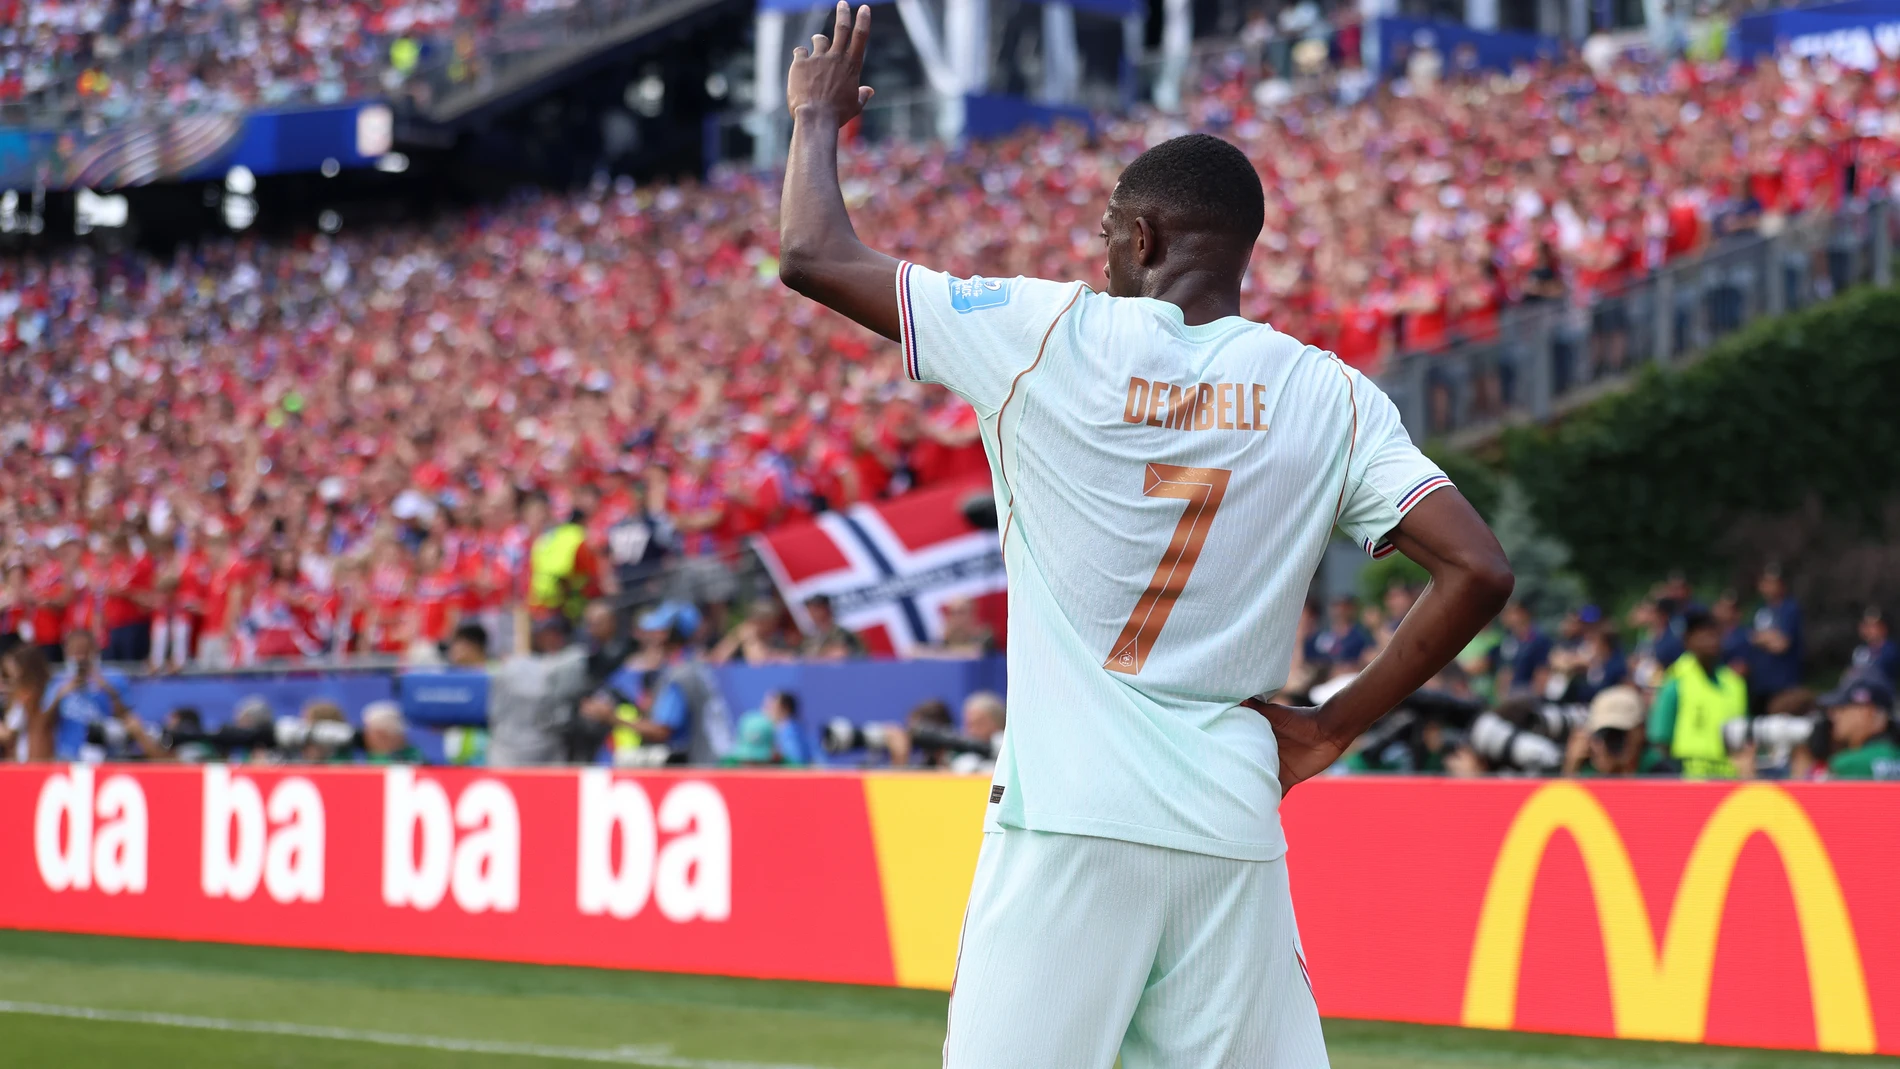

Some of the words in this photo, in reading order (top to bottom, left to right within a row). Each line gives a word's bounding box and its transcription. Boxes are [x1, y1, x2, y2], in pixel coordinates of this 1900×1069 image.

[1123, 376, 1268, 432] DEMBELE
[1103, 462, 1233, 676] 7
[35, 764, 148, 894] da
[202, 764, 325, 904] ba
[382, 765, 520, 913] ba
[576, 767, 732, 922] ba
